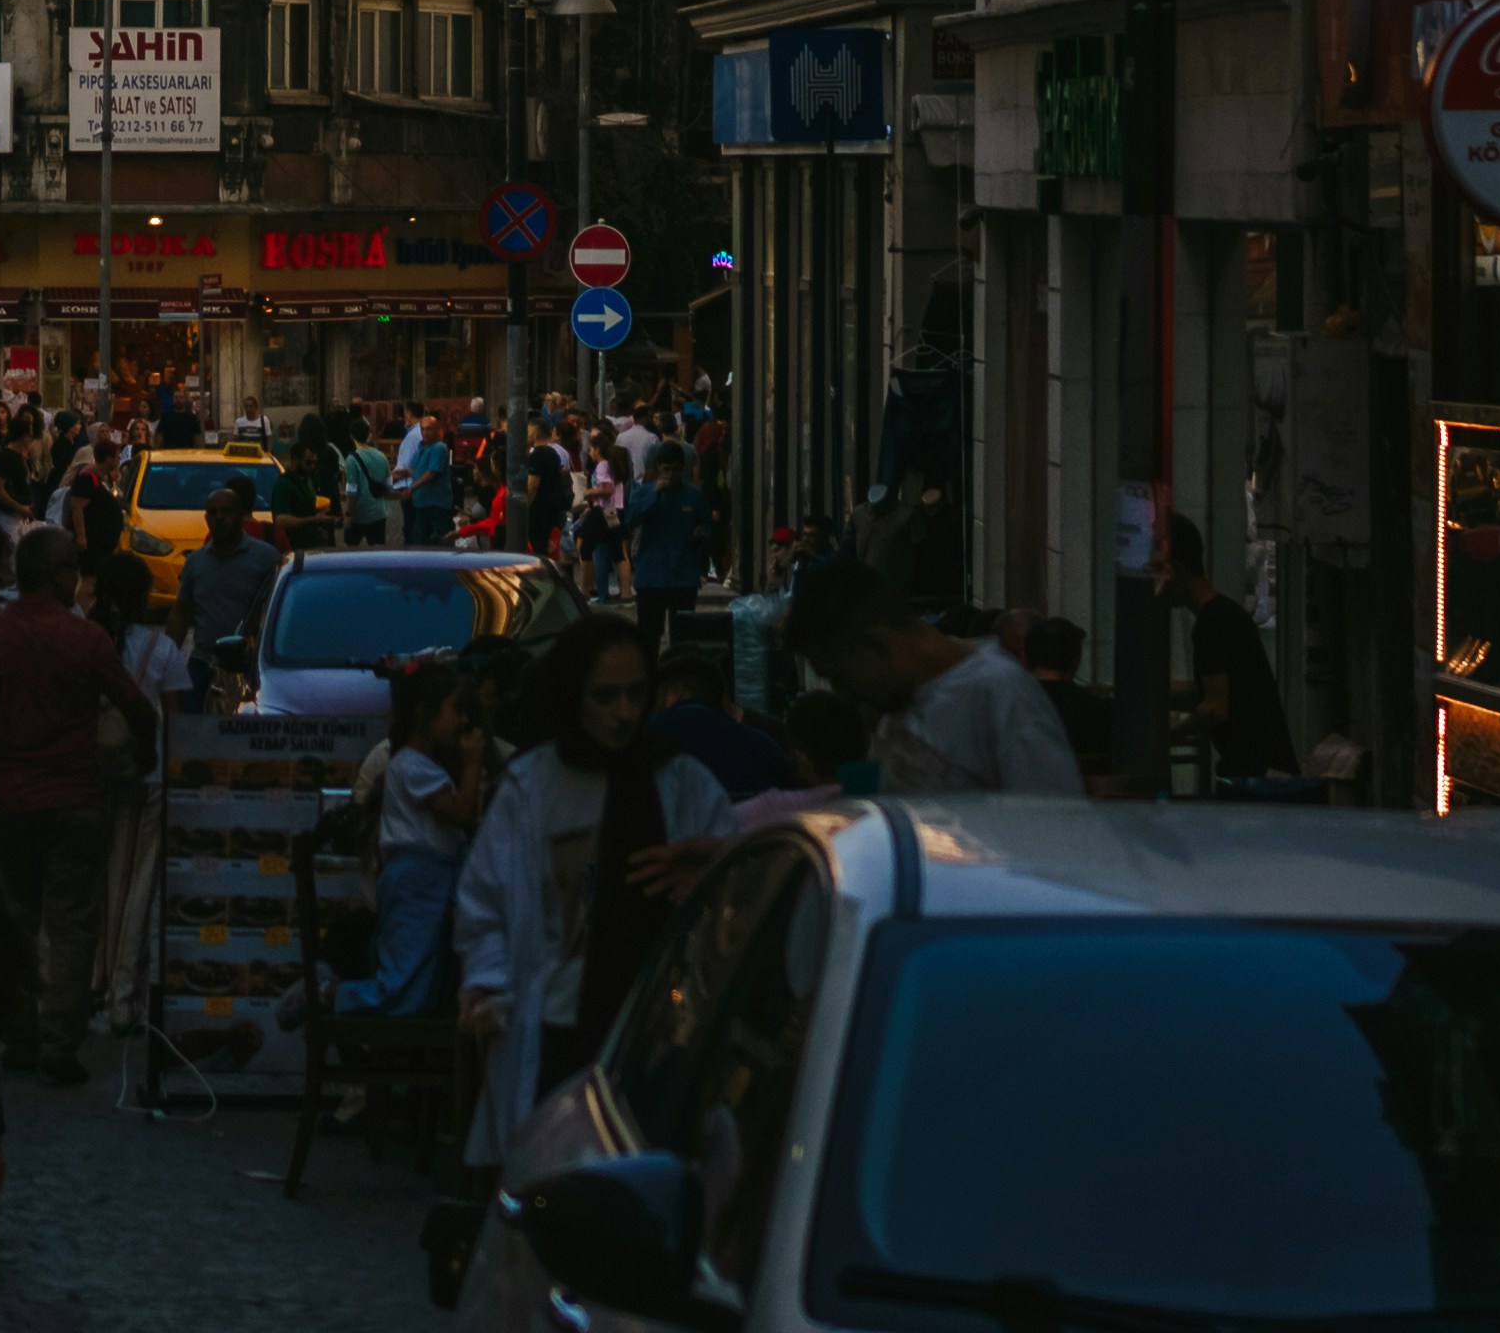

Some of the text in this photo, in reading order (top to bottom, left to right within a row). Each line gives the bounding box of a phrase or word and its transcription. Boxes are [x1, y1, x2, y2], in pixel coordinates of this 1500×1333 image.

[144, 99, 156, 114] ve
[170, 120, 185, 133] 66
[190, 120, 204, 133] 77
[73, 232, 217, 256] KOSKA
[261, 229, 388, 270] KOSKA
[60, 305, 99, 315] KOSK
